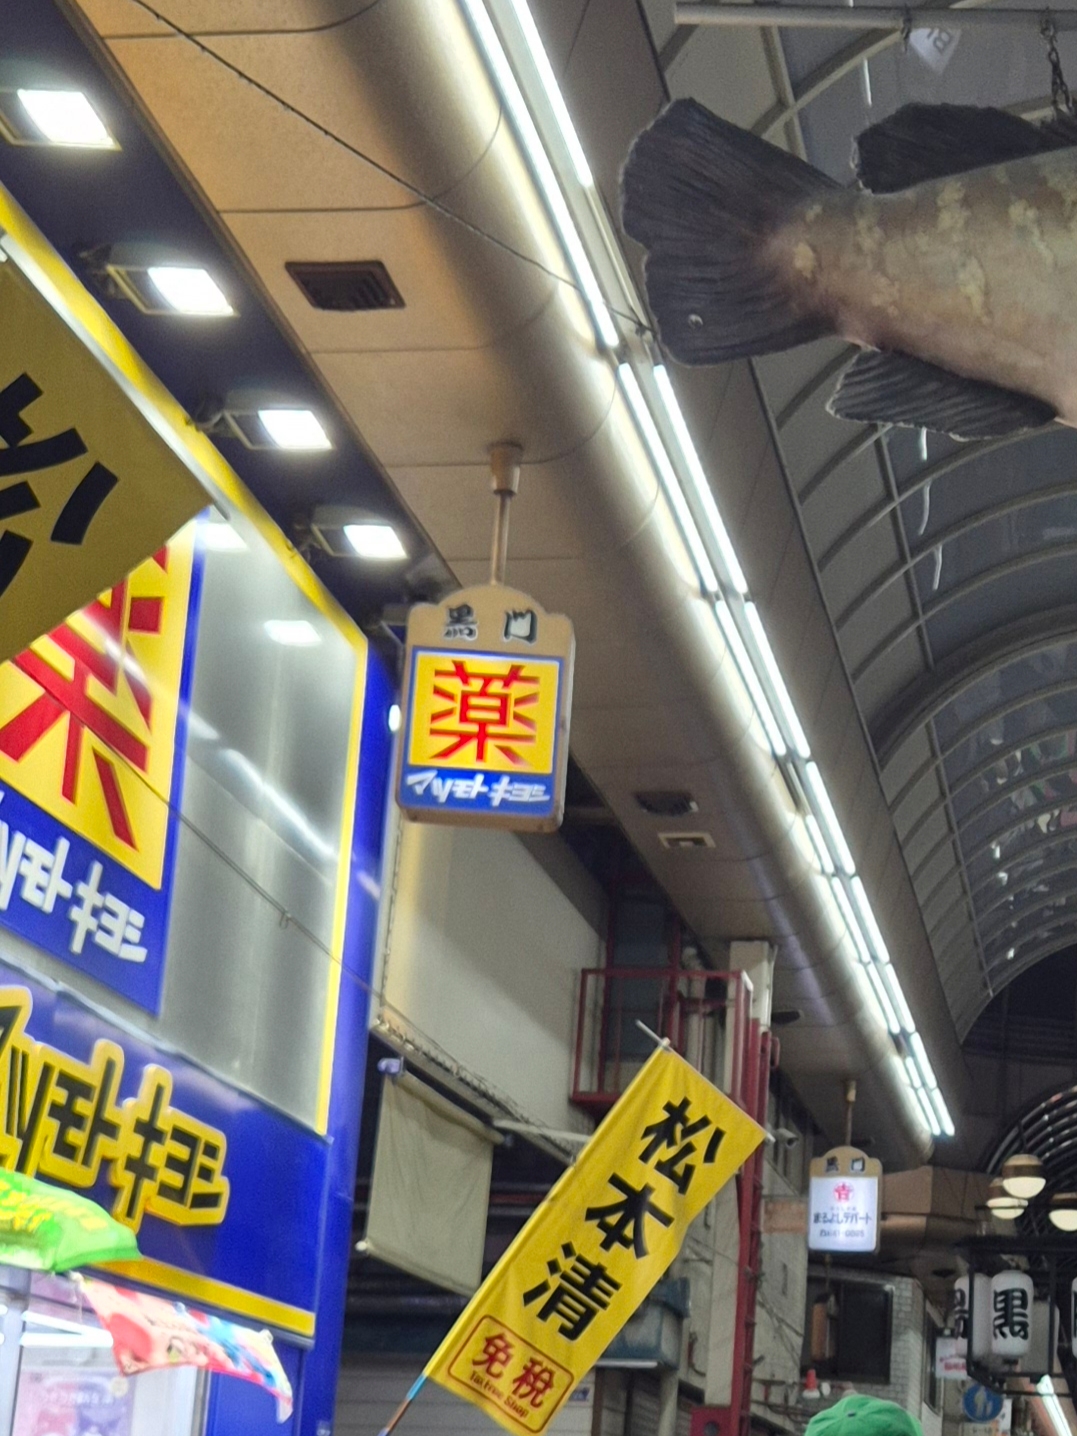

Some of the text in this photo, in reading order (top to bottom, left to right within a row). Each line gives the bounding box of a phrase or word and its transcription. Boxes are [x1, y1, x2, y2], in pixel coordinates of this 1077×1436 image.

[429, 660, 541, 768] 薬
[406, 769, 551, 808] マツモトキヨシ
[0, 800, 148, 963] ツモトキヨシ
[522, 1096, 726, 1342] 松本清
